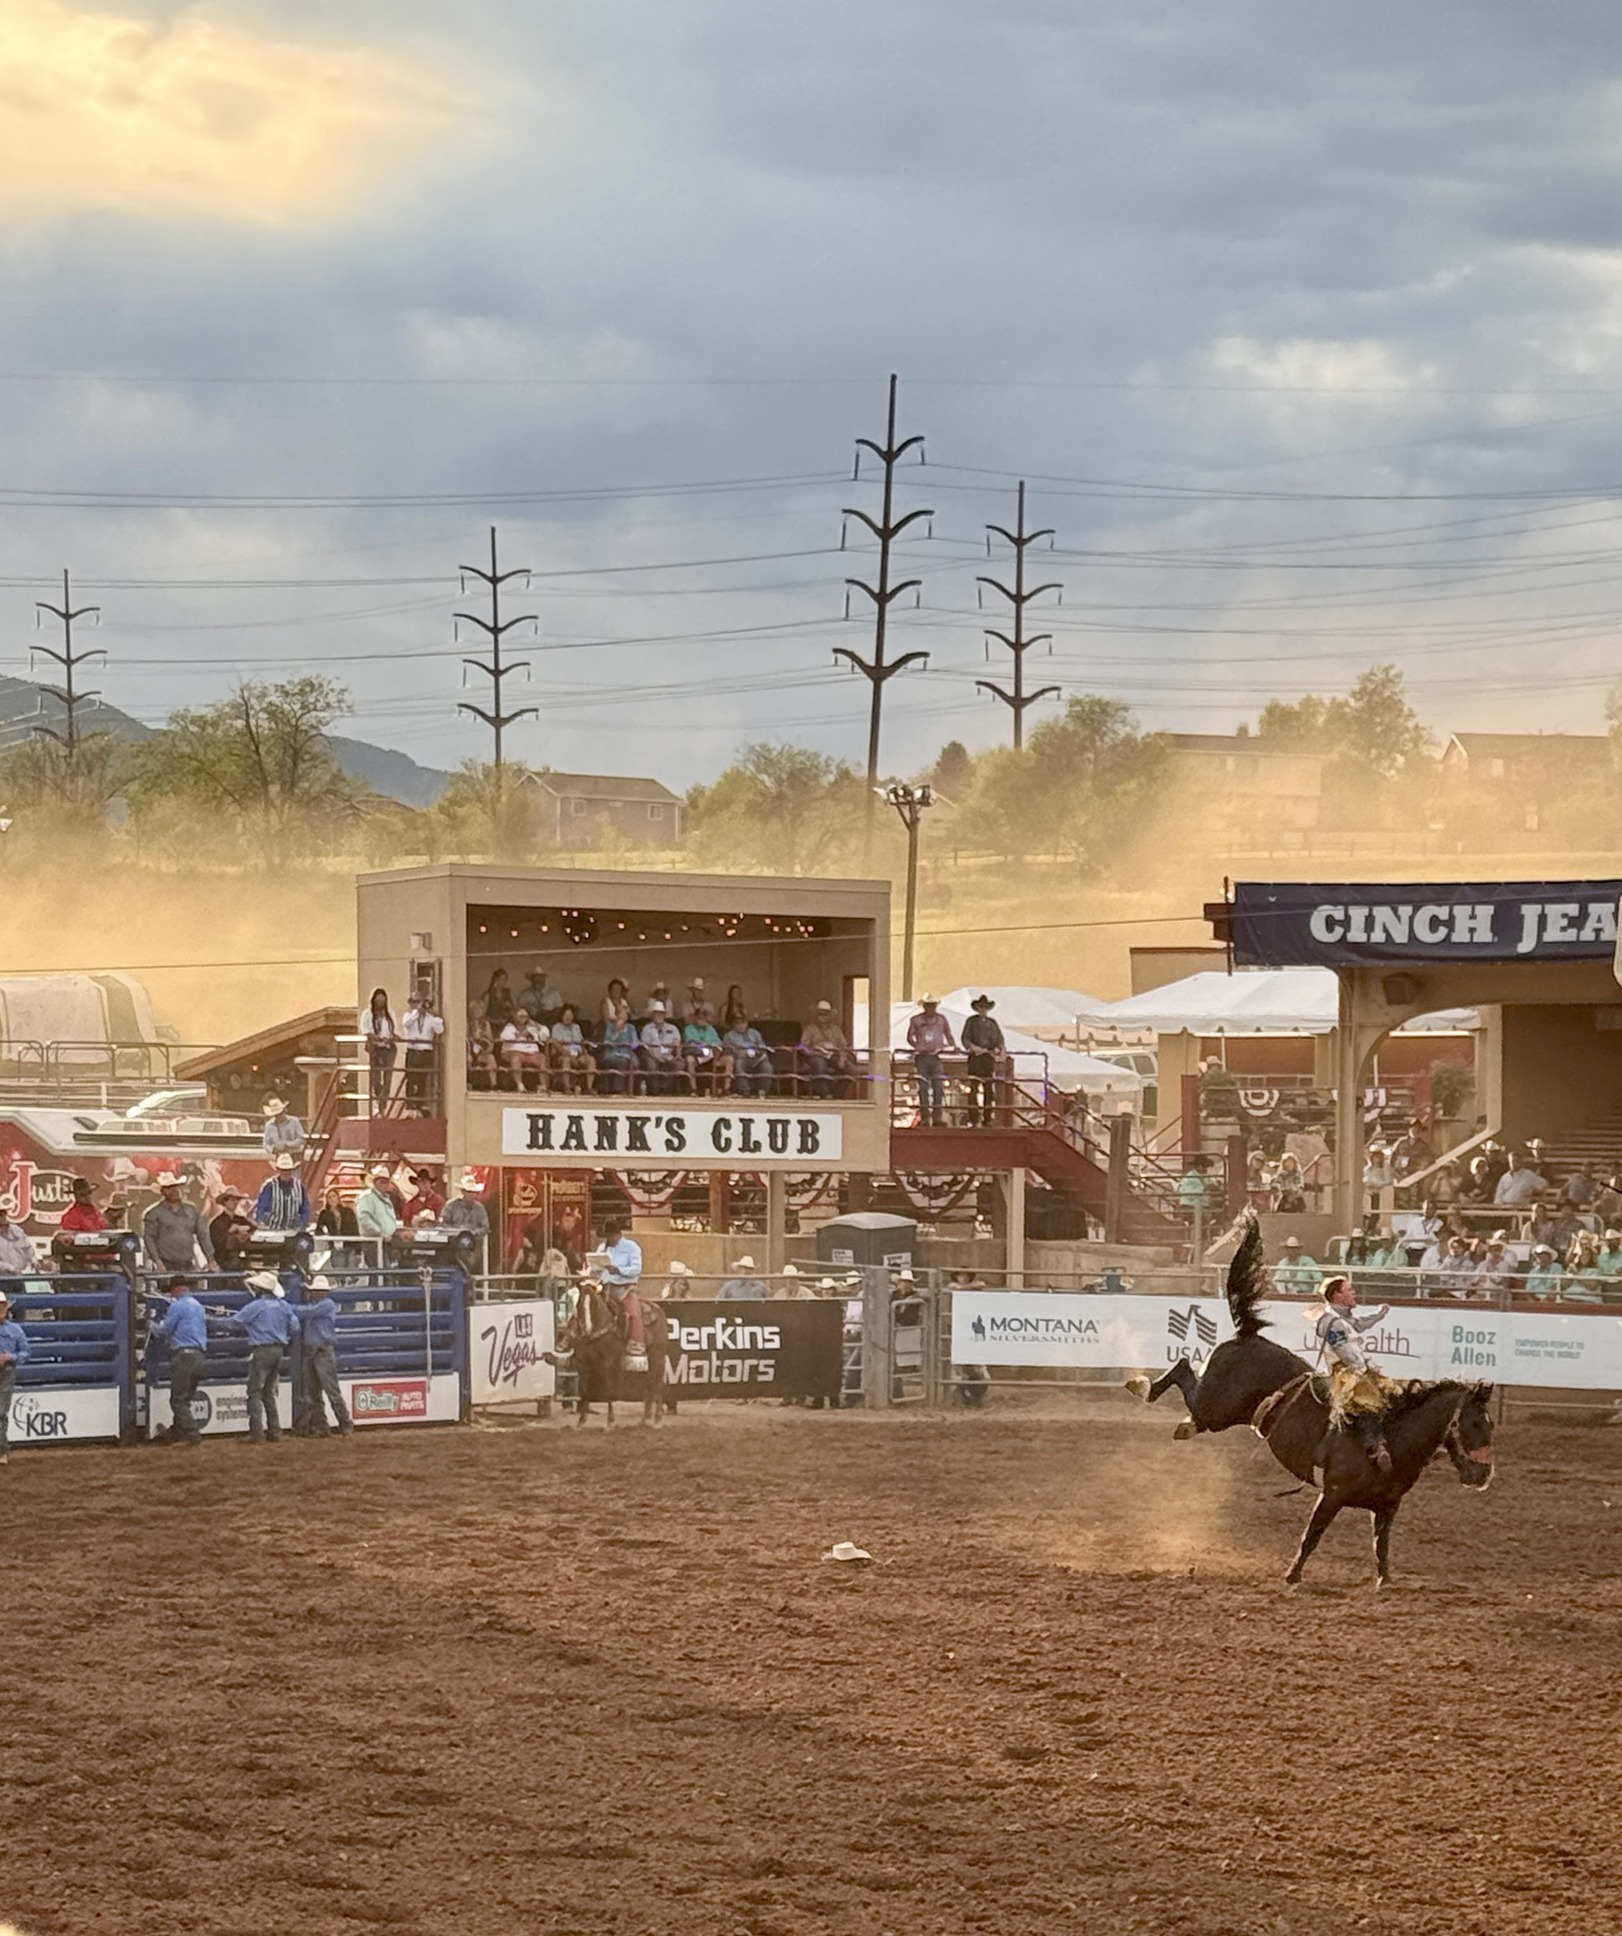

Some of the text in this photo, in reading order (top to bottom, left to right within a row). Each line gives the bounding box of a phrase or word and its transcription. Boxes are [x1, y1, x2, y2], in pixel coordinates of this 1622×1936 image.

[1310, 904, 1495, 944] CINCH
[526, 1113, 821, 1154] HANK'S CLUB
[989, 1317, 1099, 1334] MONTANA
[1451, 1324, 1496, 1345] Booz
[481, 1320, 543, 1389] Vegas
[663, 1350, 776, 1385] Motors
[1450, 1346, 1497, 1367] Allen
[402, 1391, 423, 1401] AUTO
[26, 1411, 68, 1437] KBR
